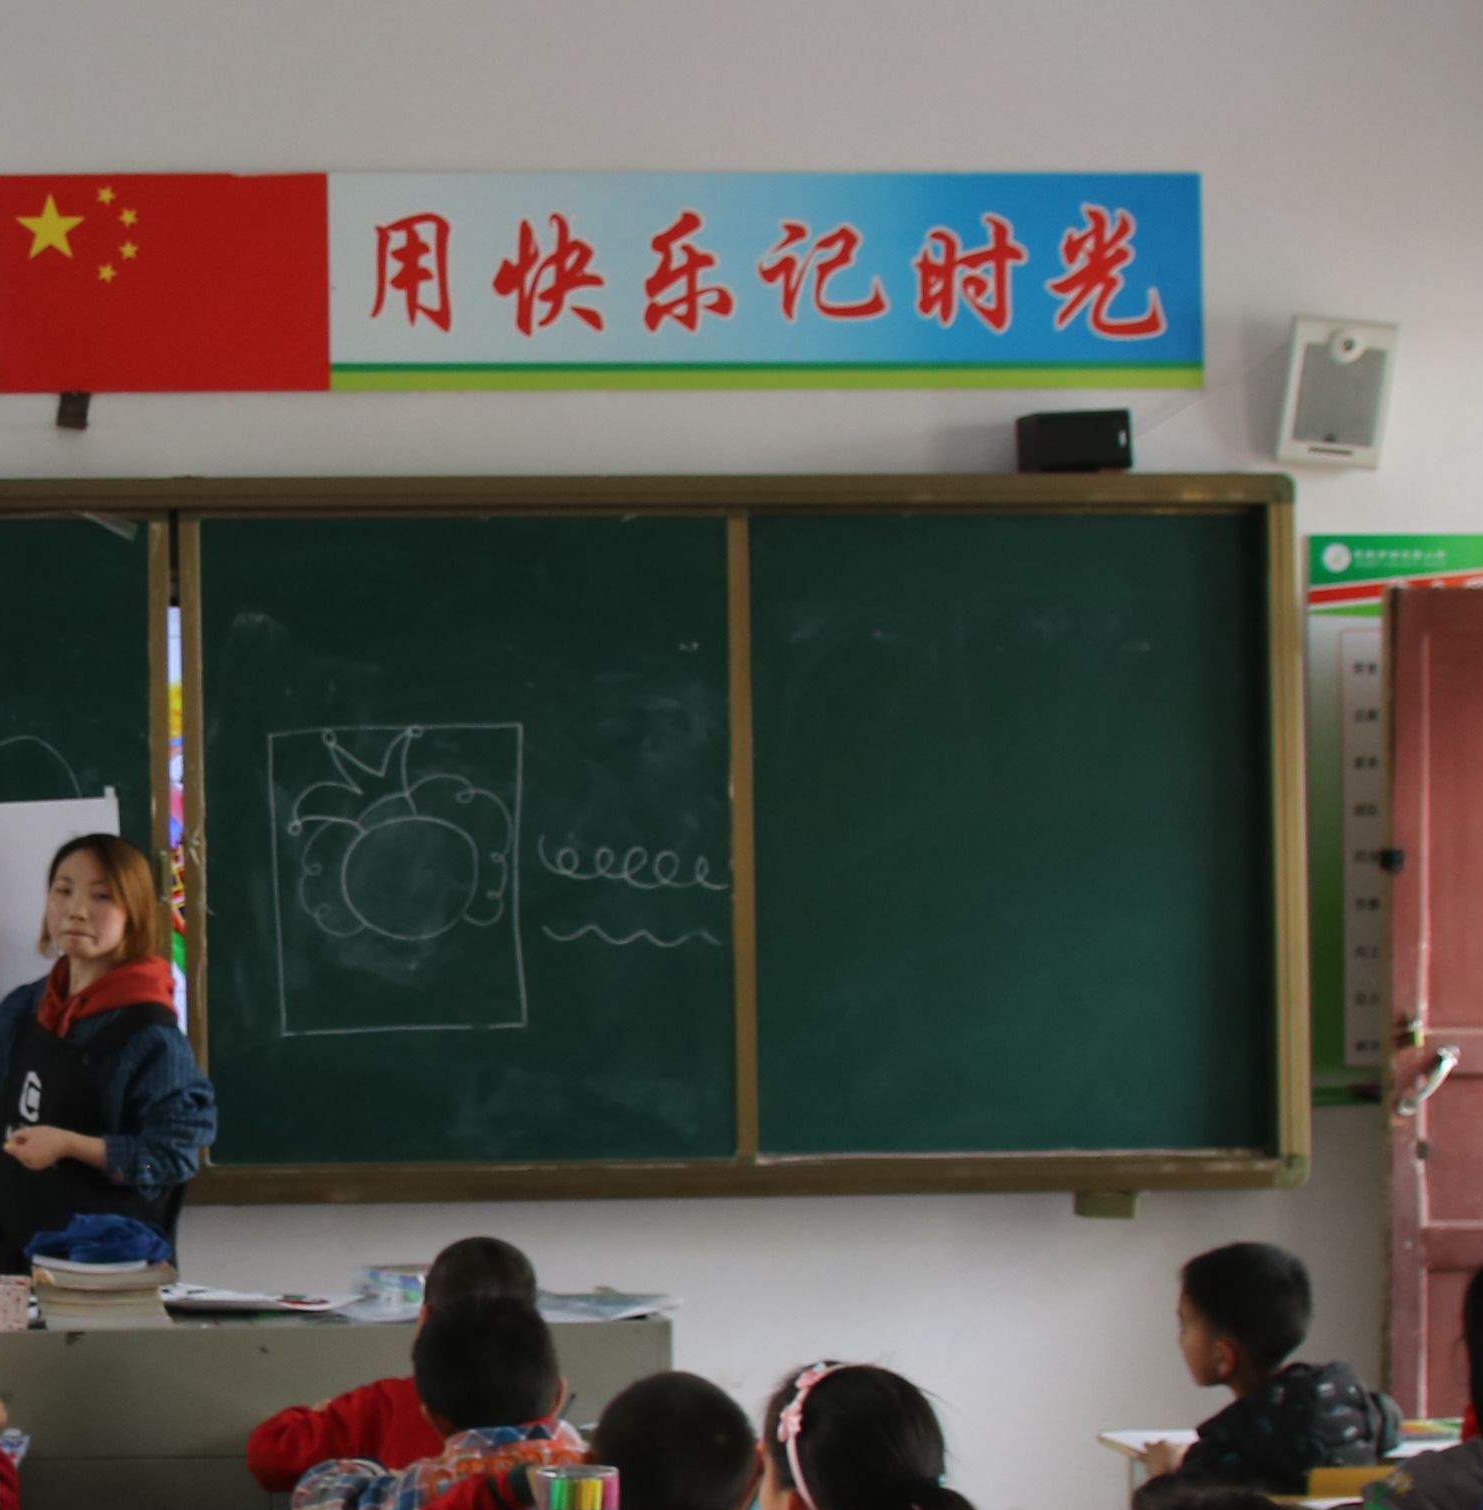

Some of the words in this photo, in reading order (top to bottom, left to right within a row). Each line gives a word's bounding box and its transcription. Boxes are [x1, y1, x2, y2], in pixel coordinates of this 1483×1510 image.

[370, 204, 1167, 339] 用快乐记时光
